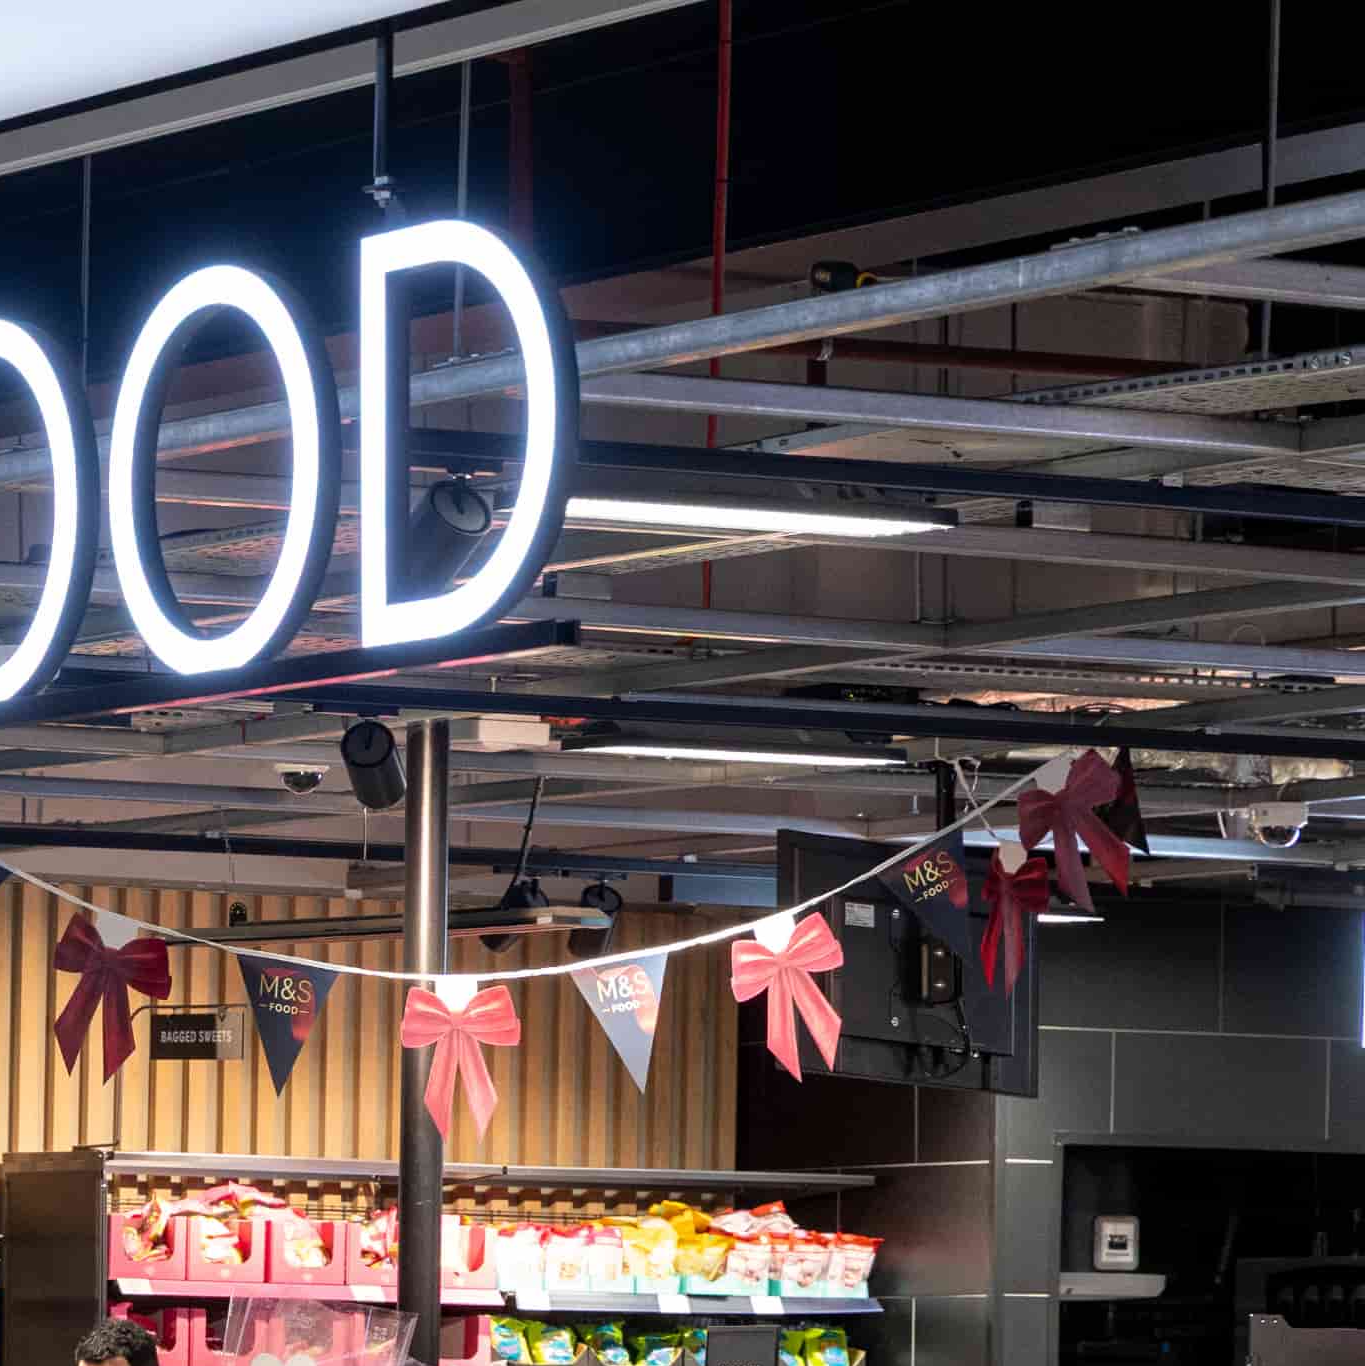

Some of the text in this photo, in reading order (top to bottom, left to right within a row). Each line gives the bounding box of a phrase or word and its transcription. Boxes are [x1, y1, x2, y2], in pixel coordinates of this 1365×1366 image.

[902, 850, 954, 894] M&S
[922, 880, 949, 900] FOOD
[259, 974, 313, 1003] M&S
[596, 971, 647, 1003] M&S
[268, 1003, 299, 1015] FOOD
[160, 1030, 233, 1043] BAGGED SWEETS
